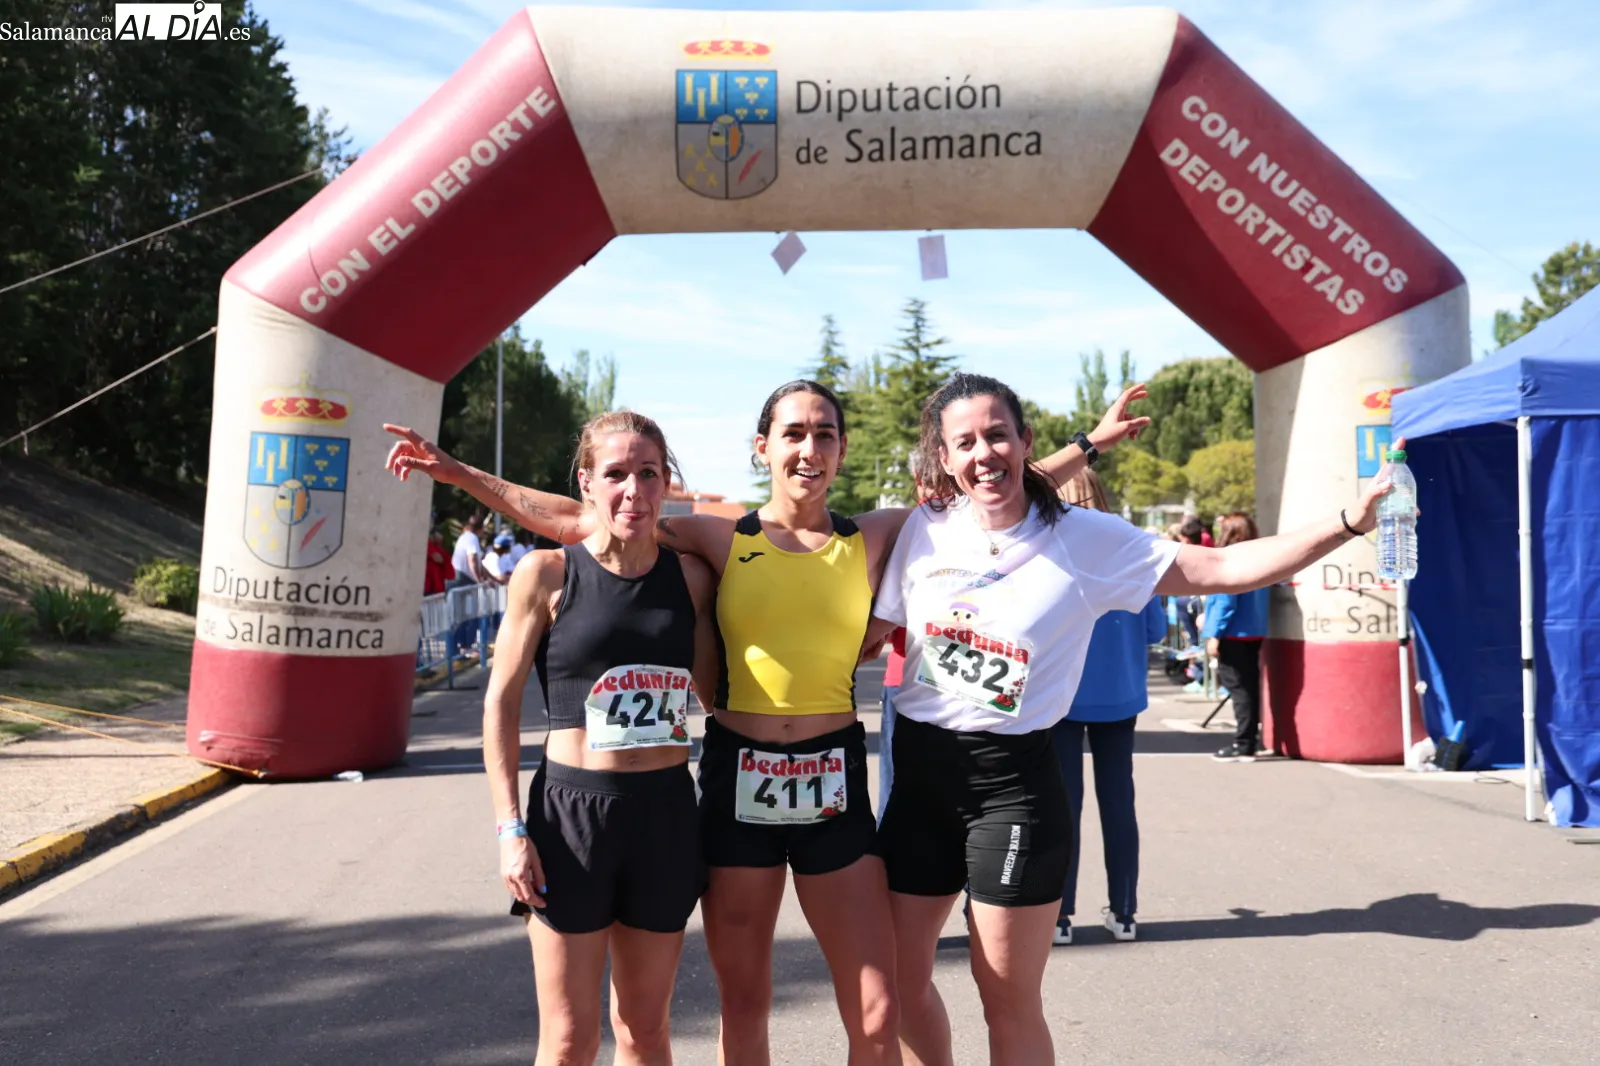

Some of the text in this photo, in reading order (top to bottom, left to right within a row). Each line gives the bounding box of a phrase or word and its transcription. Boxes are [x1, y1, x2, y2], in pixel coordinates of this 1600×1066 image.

[795, 74, 1002, 122] Diputación
[795, 126, 1042, 165] de Salamanca
[299, 86, 557, 314] CON EL DEPORTE
[1181, 95, 1409, 294] CON NUESTROS
[1158, 137, 1365, 315] DEPORTISTAS
[213, 566, 371, 606] Diputación
[1323, 563, 1396, 597] Dip
[225, 612, 384, 649] Salamanca
[1306, 605, 1398, 634] de Sal
[925, 622, 1029, 664] bedunia
[937, 642, 1010, 694] 432
[606, 691, 675, 728] 424
[740, 752, 843, 776] bedunia
[753, 775, 823, 809] 411
